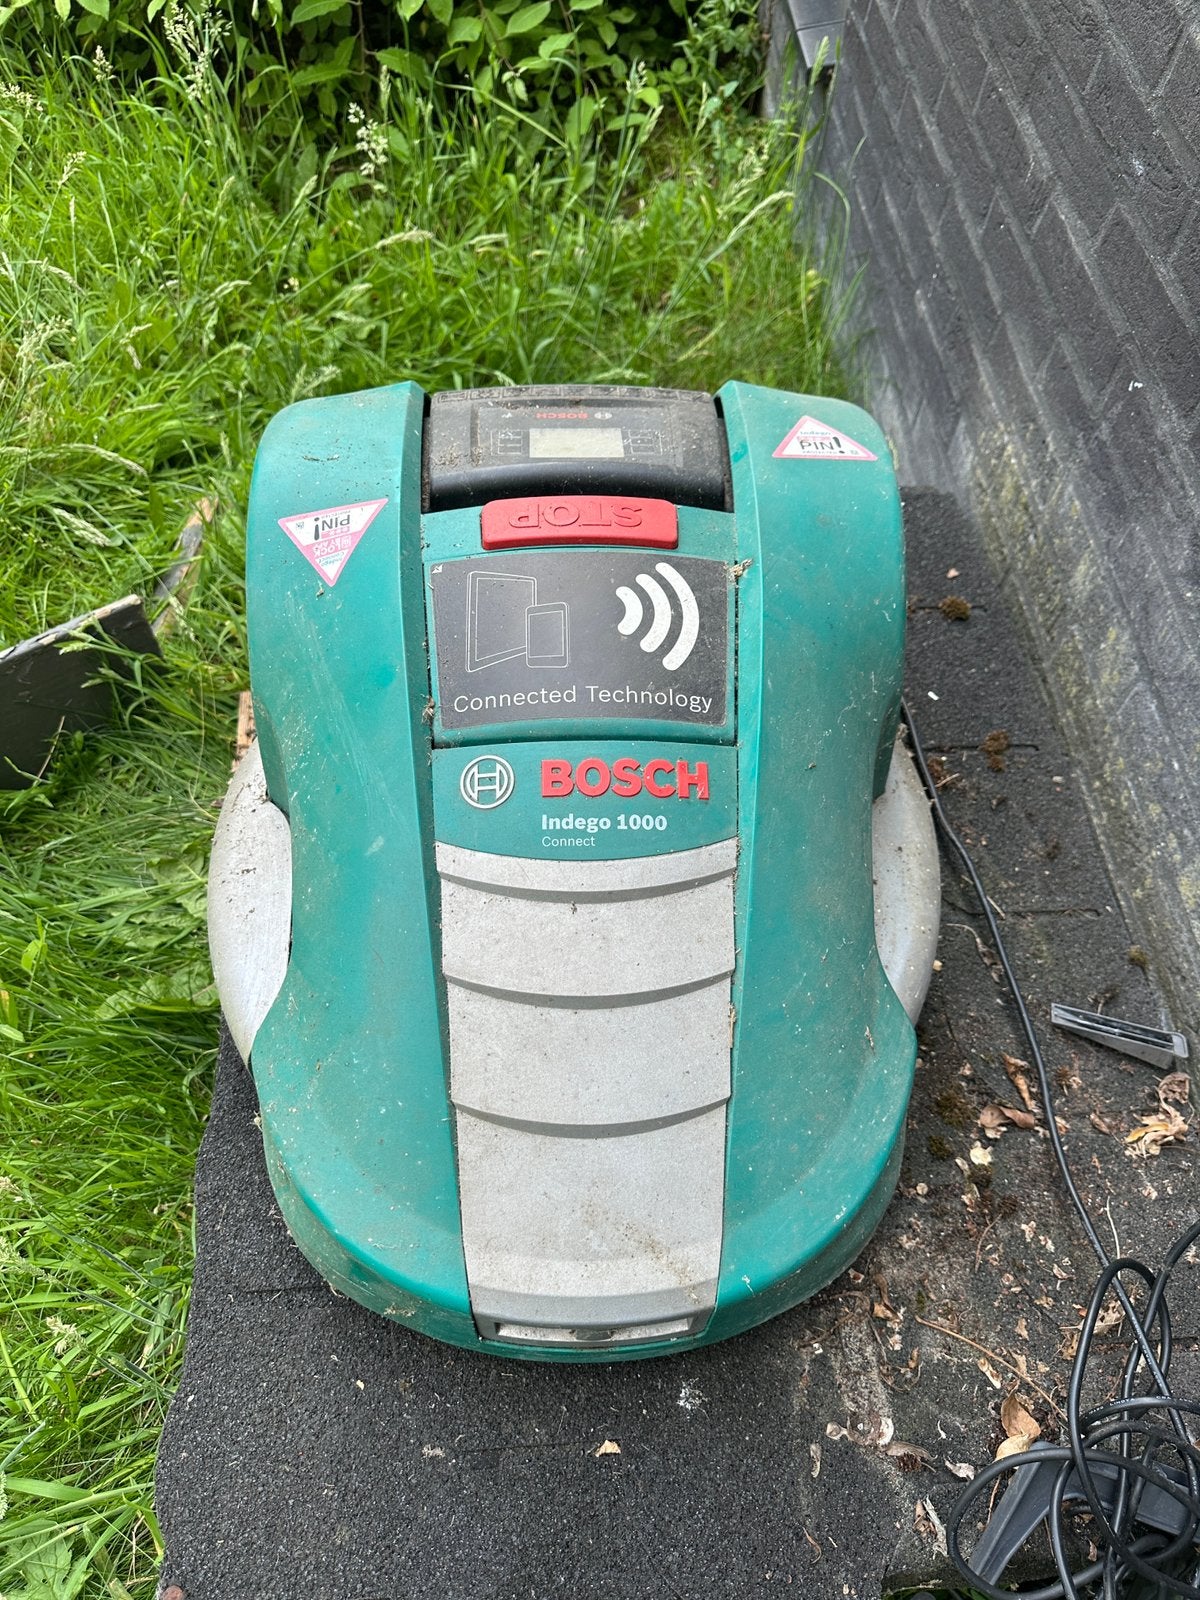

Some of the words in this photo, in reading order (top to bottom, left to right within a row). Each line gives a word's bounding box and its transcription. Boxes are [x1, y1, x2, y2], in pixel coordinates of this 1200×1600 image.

[508, 503, 643, 529] STOP
[454, 685, 577, 713] Connected
[585, 685, 713, 714] Technology
[540, 757, 709, 799] BOSCH
[541, 814, 612, 833] Indego
[616, 814, 668, 831] 1000
[541, 836, 596, 848] Connect
